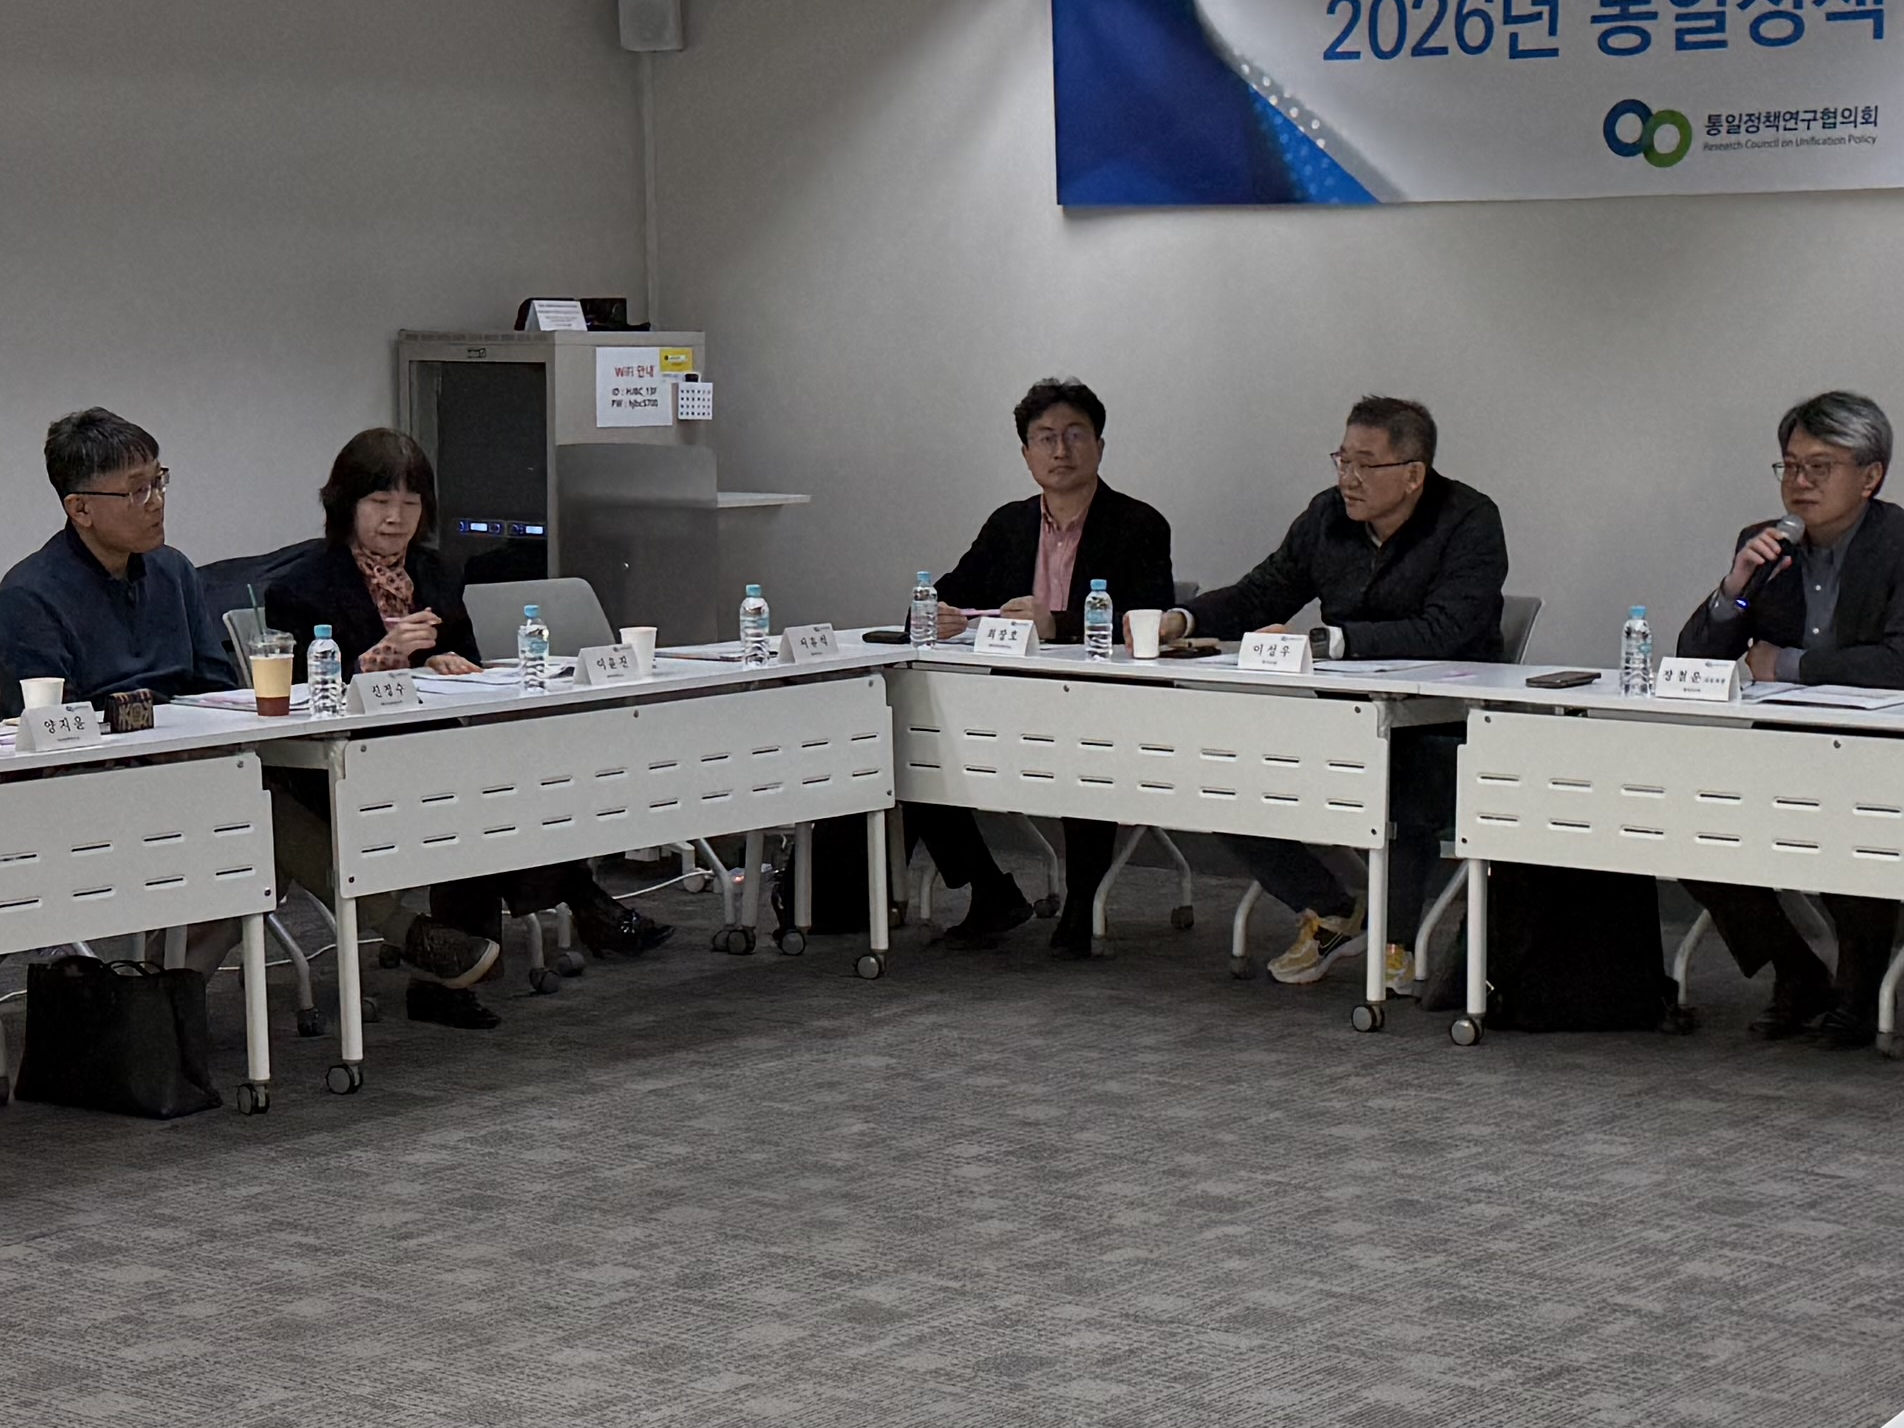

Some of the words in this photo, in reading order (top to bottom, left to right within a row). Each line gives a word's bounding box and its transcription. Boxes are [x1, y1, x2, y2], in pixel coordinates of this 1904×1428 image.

[1704, 105, 1878, 137] 통일정책연구협의회
[1745, 139, 1779, 150] Council
[1796, 136, 1846, 147] Unification
[1848, 133, 1877, 145] Policy
